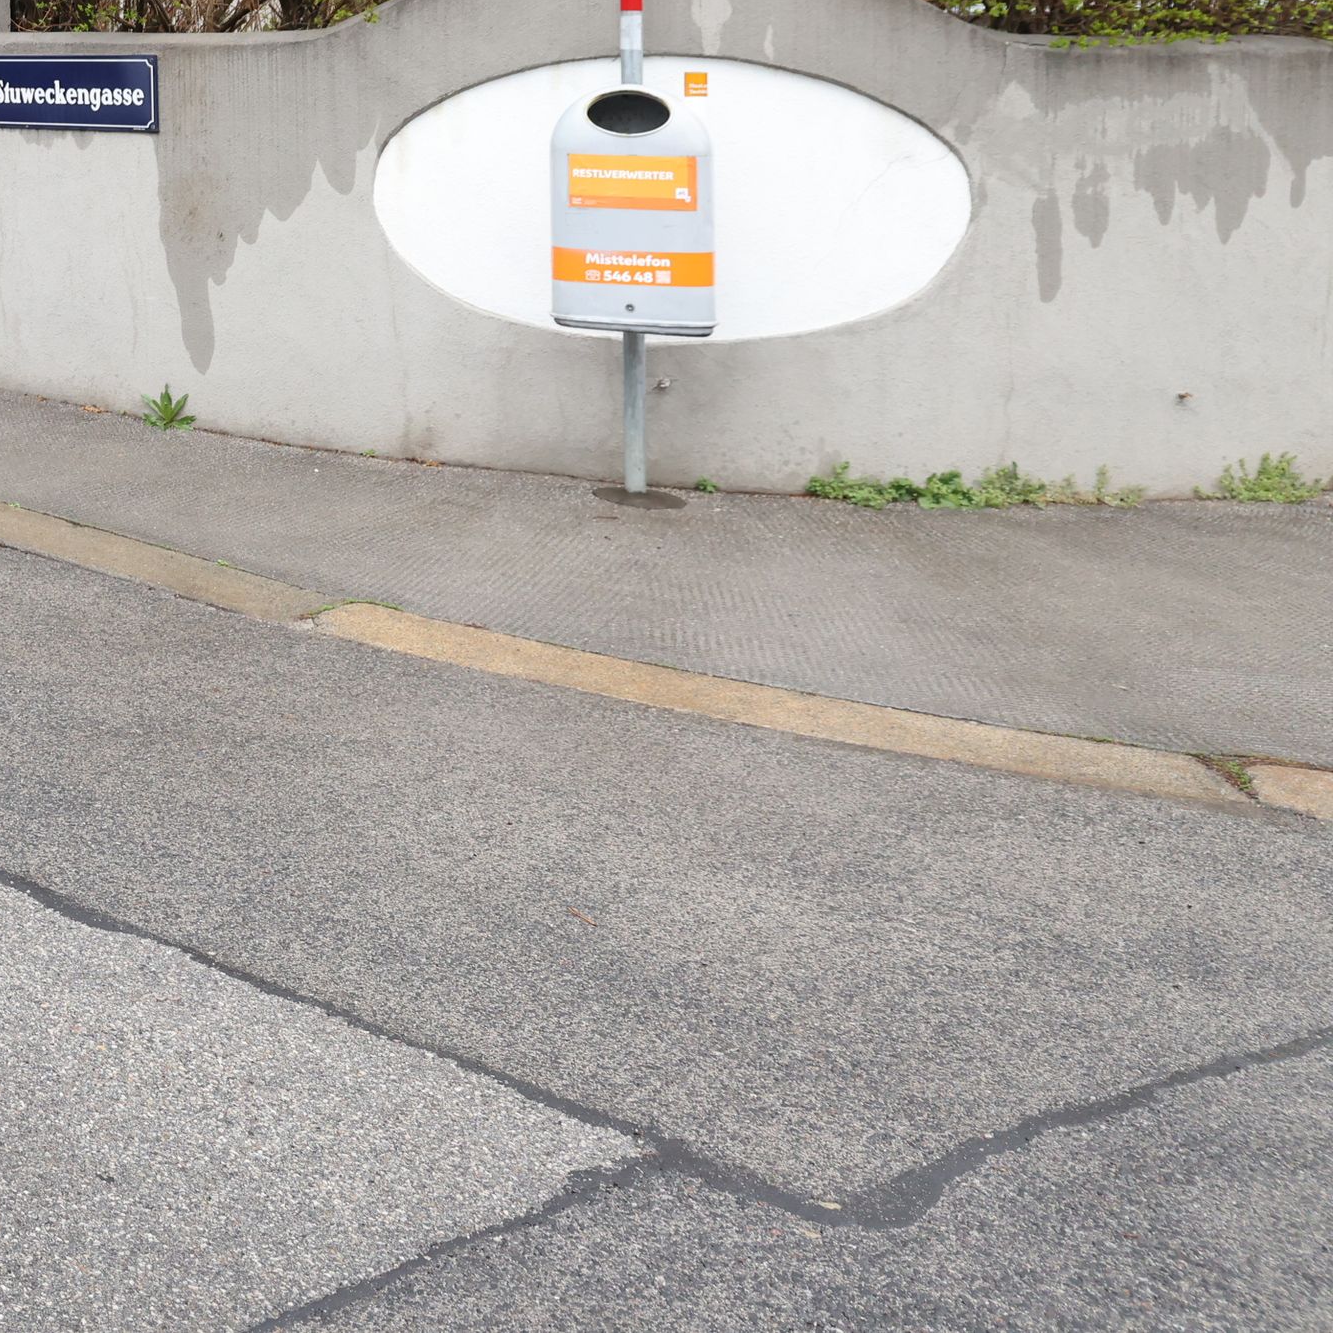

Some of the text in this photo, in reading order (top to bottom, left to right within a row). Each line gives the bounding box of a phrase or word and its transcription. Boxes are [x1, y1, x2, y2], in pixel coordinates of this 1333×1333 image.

[572, 168, 675, 181] RESTLVERWERTER
[585, 252, 671, 267] Misttelefon
[603, 270, 654, 283] 546 48
